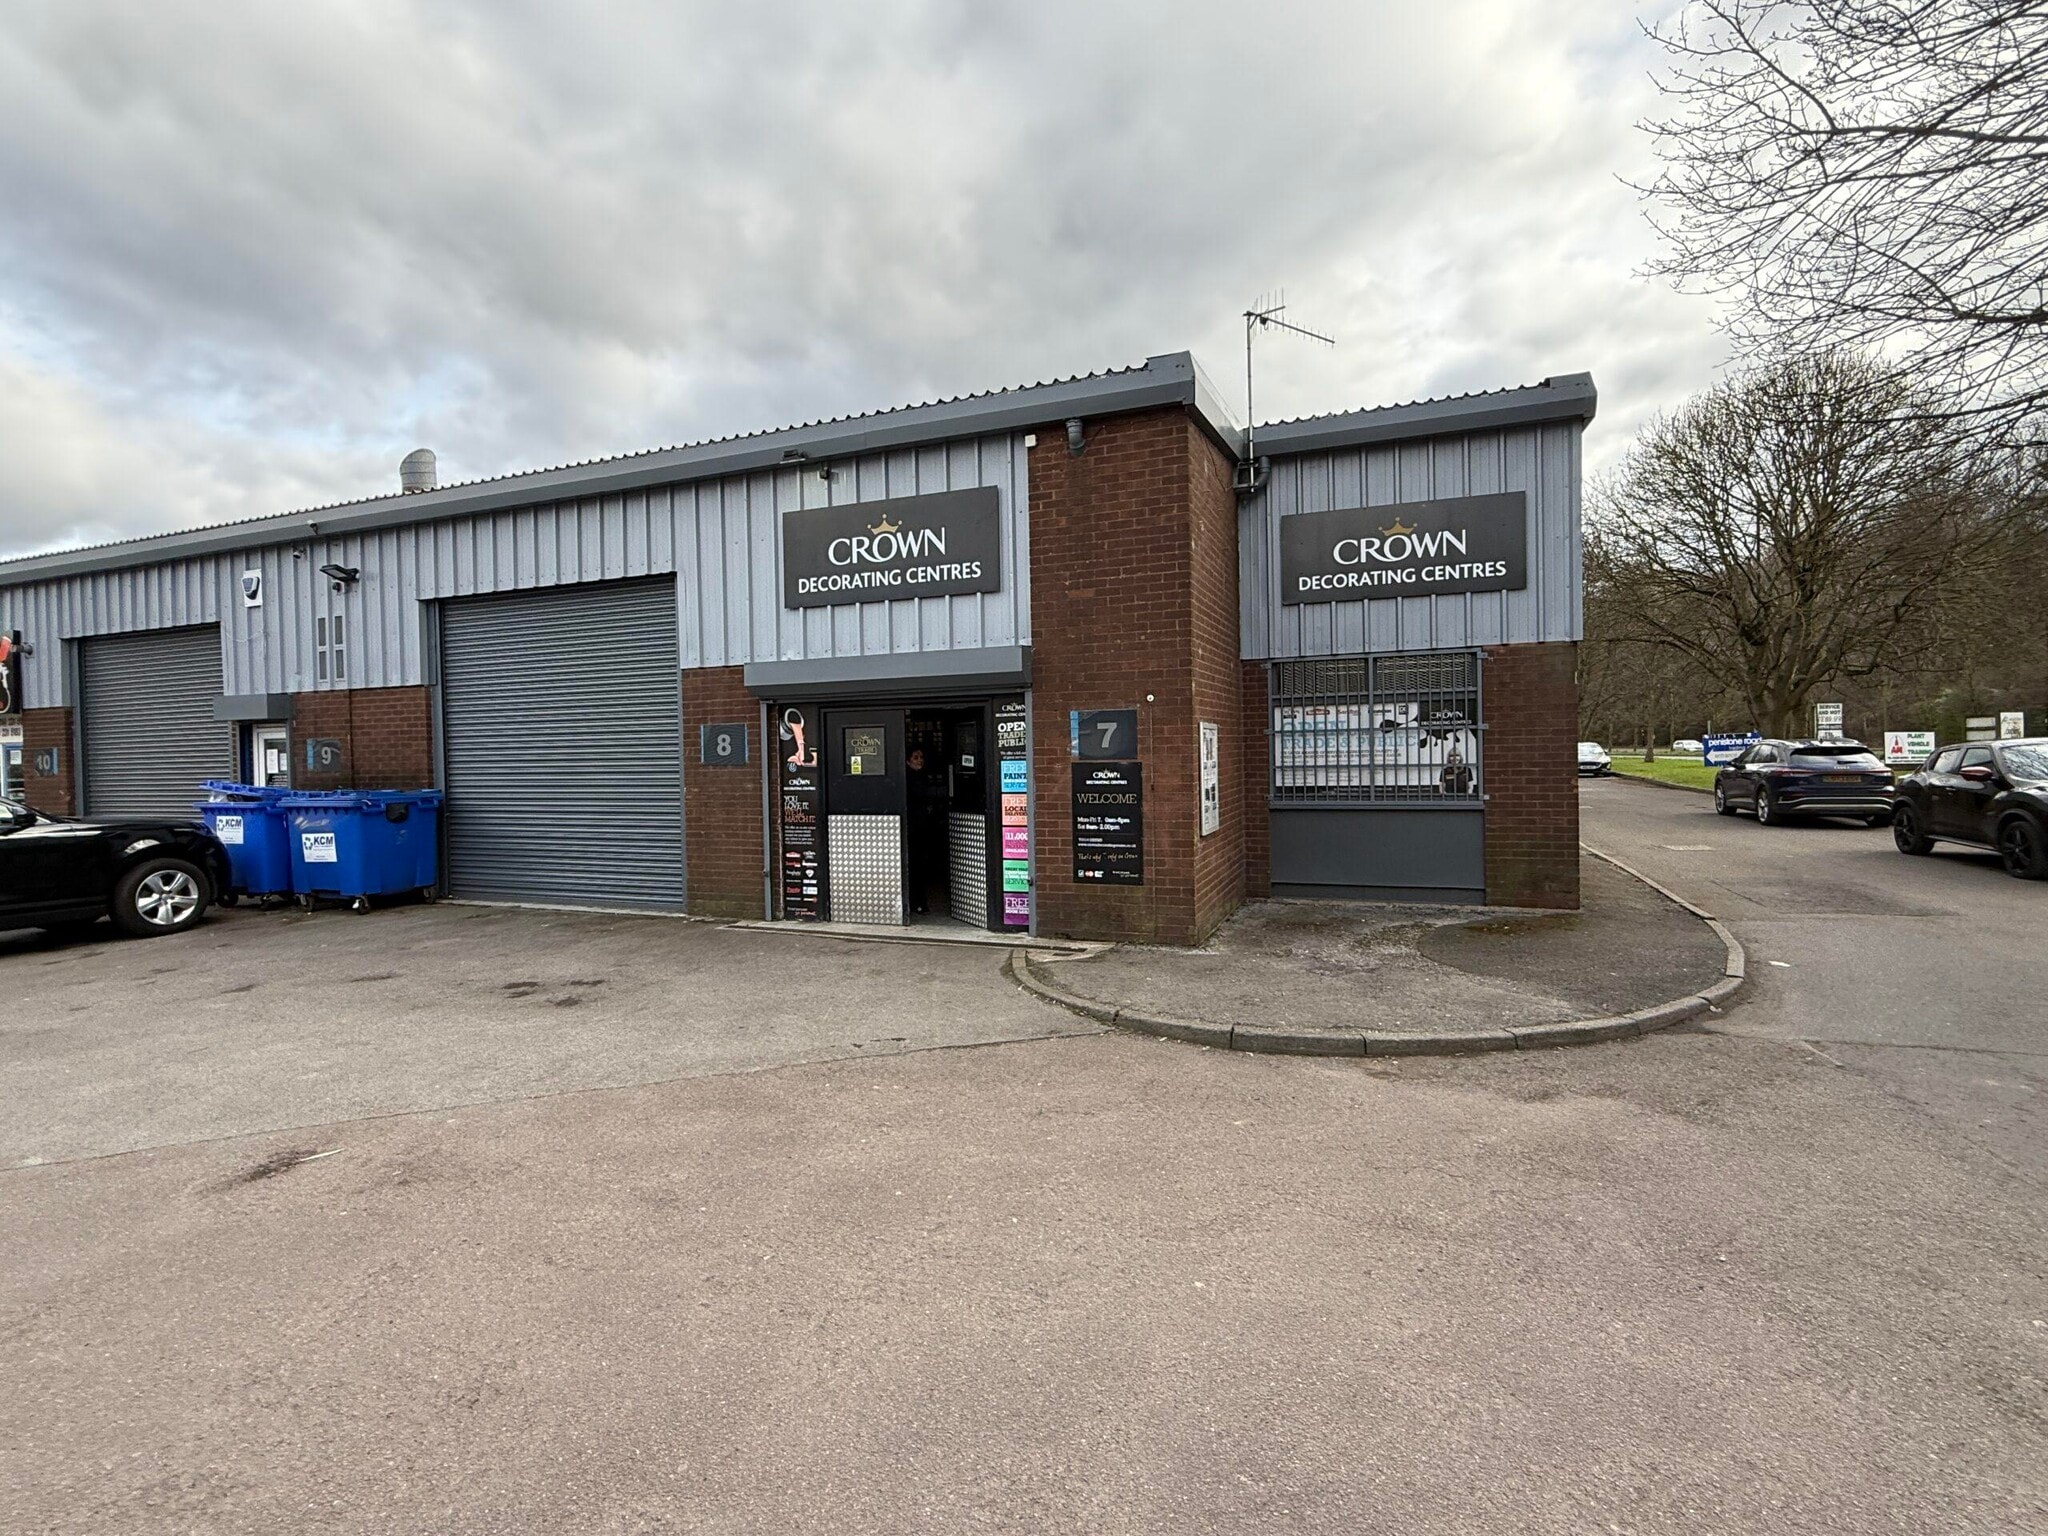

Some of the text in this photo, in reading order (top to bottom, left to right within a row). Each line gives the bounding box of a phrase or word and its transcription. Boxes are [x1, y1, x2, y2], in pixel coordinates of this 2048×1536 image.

[828, 527, 946, 565] CROWN
[1333, 529, 1466, 565] CROWN
[798, 562, 981, 593] DECORATING CENTRES
[1299, 561, 1507, 590] DECORATING CENTRES
[1430, 711, 1463, 719] CROWN
[997, 721, 1026, 733] OPEN
[1097, 722, 1118, 749] 7
[1356, 734, 1418, 747] PBLIC
[716, 733, 732, 756] 8
[998, 738, 1026, 748] PUBLI
[321, 746, 332, 765] 9
[36, 754, 50, 771] 10
[1092, 771, 1121, 779] CROWN
[783, 795, 798, 803] YOU
[1076, 793, 1138, 804] WELCOME
[225, 818, 242, 827] KCM
[313, 836, 333, 846] KCM
